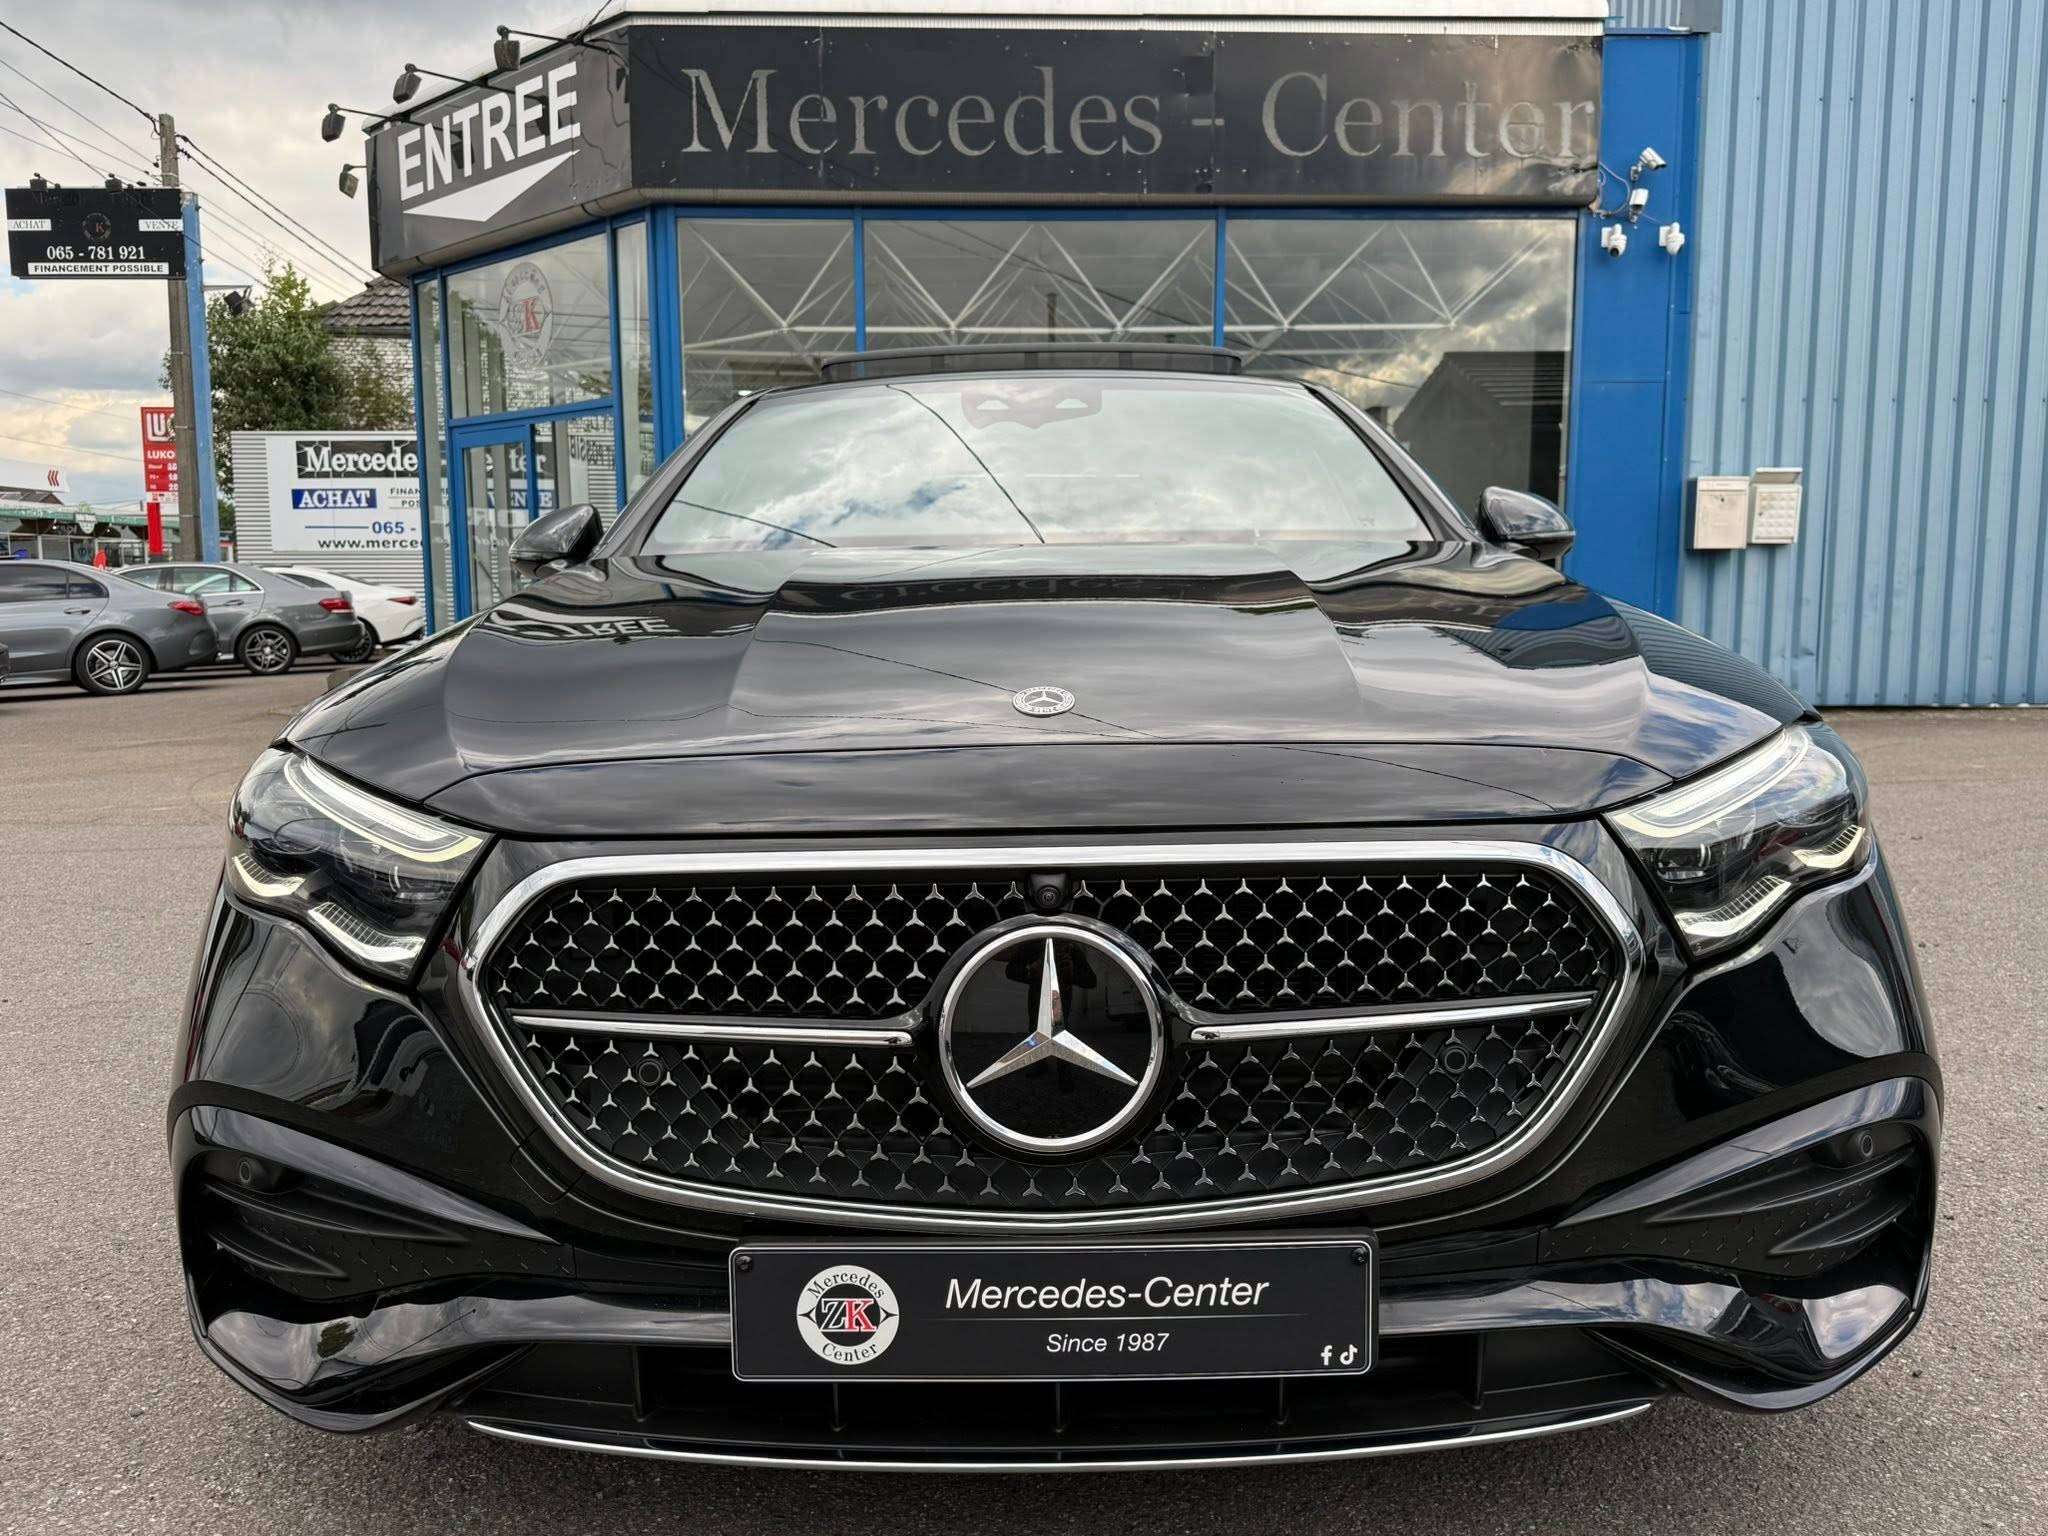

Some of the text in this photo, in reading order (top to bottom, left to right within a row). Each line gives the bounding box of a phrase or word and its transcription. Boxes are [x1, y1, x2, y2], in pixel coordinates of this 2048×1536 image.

[681, 65, 1163, 157] Mercedes
[1262, 71, 1595, 158] Center
[398, 61, 581, 201] ENTREE
[13, 220, 45, 229] ACHAT
[47, 246, 74, 260] 065
[88, 246, 114, 260] 781
[119, 246, 145, 260] 921
[34, 264, 163, 273] FINANCEMENT POSSIBLE
[298, 490, 370, 508] ACHAT
[372, 521, 405, 534] 065
[807, 1272, 885, 1299] Mercedes
[945, 1276, 1270, 1309] Mercedes-Center
[820, 1297, 877, 1332] ZK
[1046, 1333, 1169, 1352] Since 1987
[822, 1343, 877, 1361] Center
